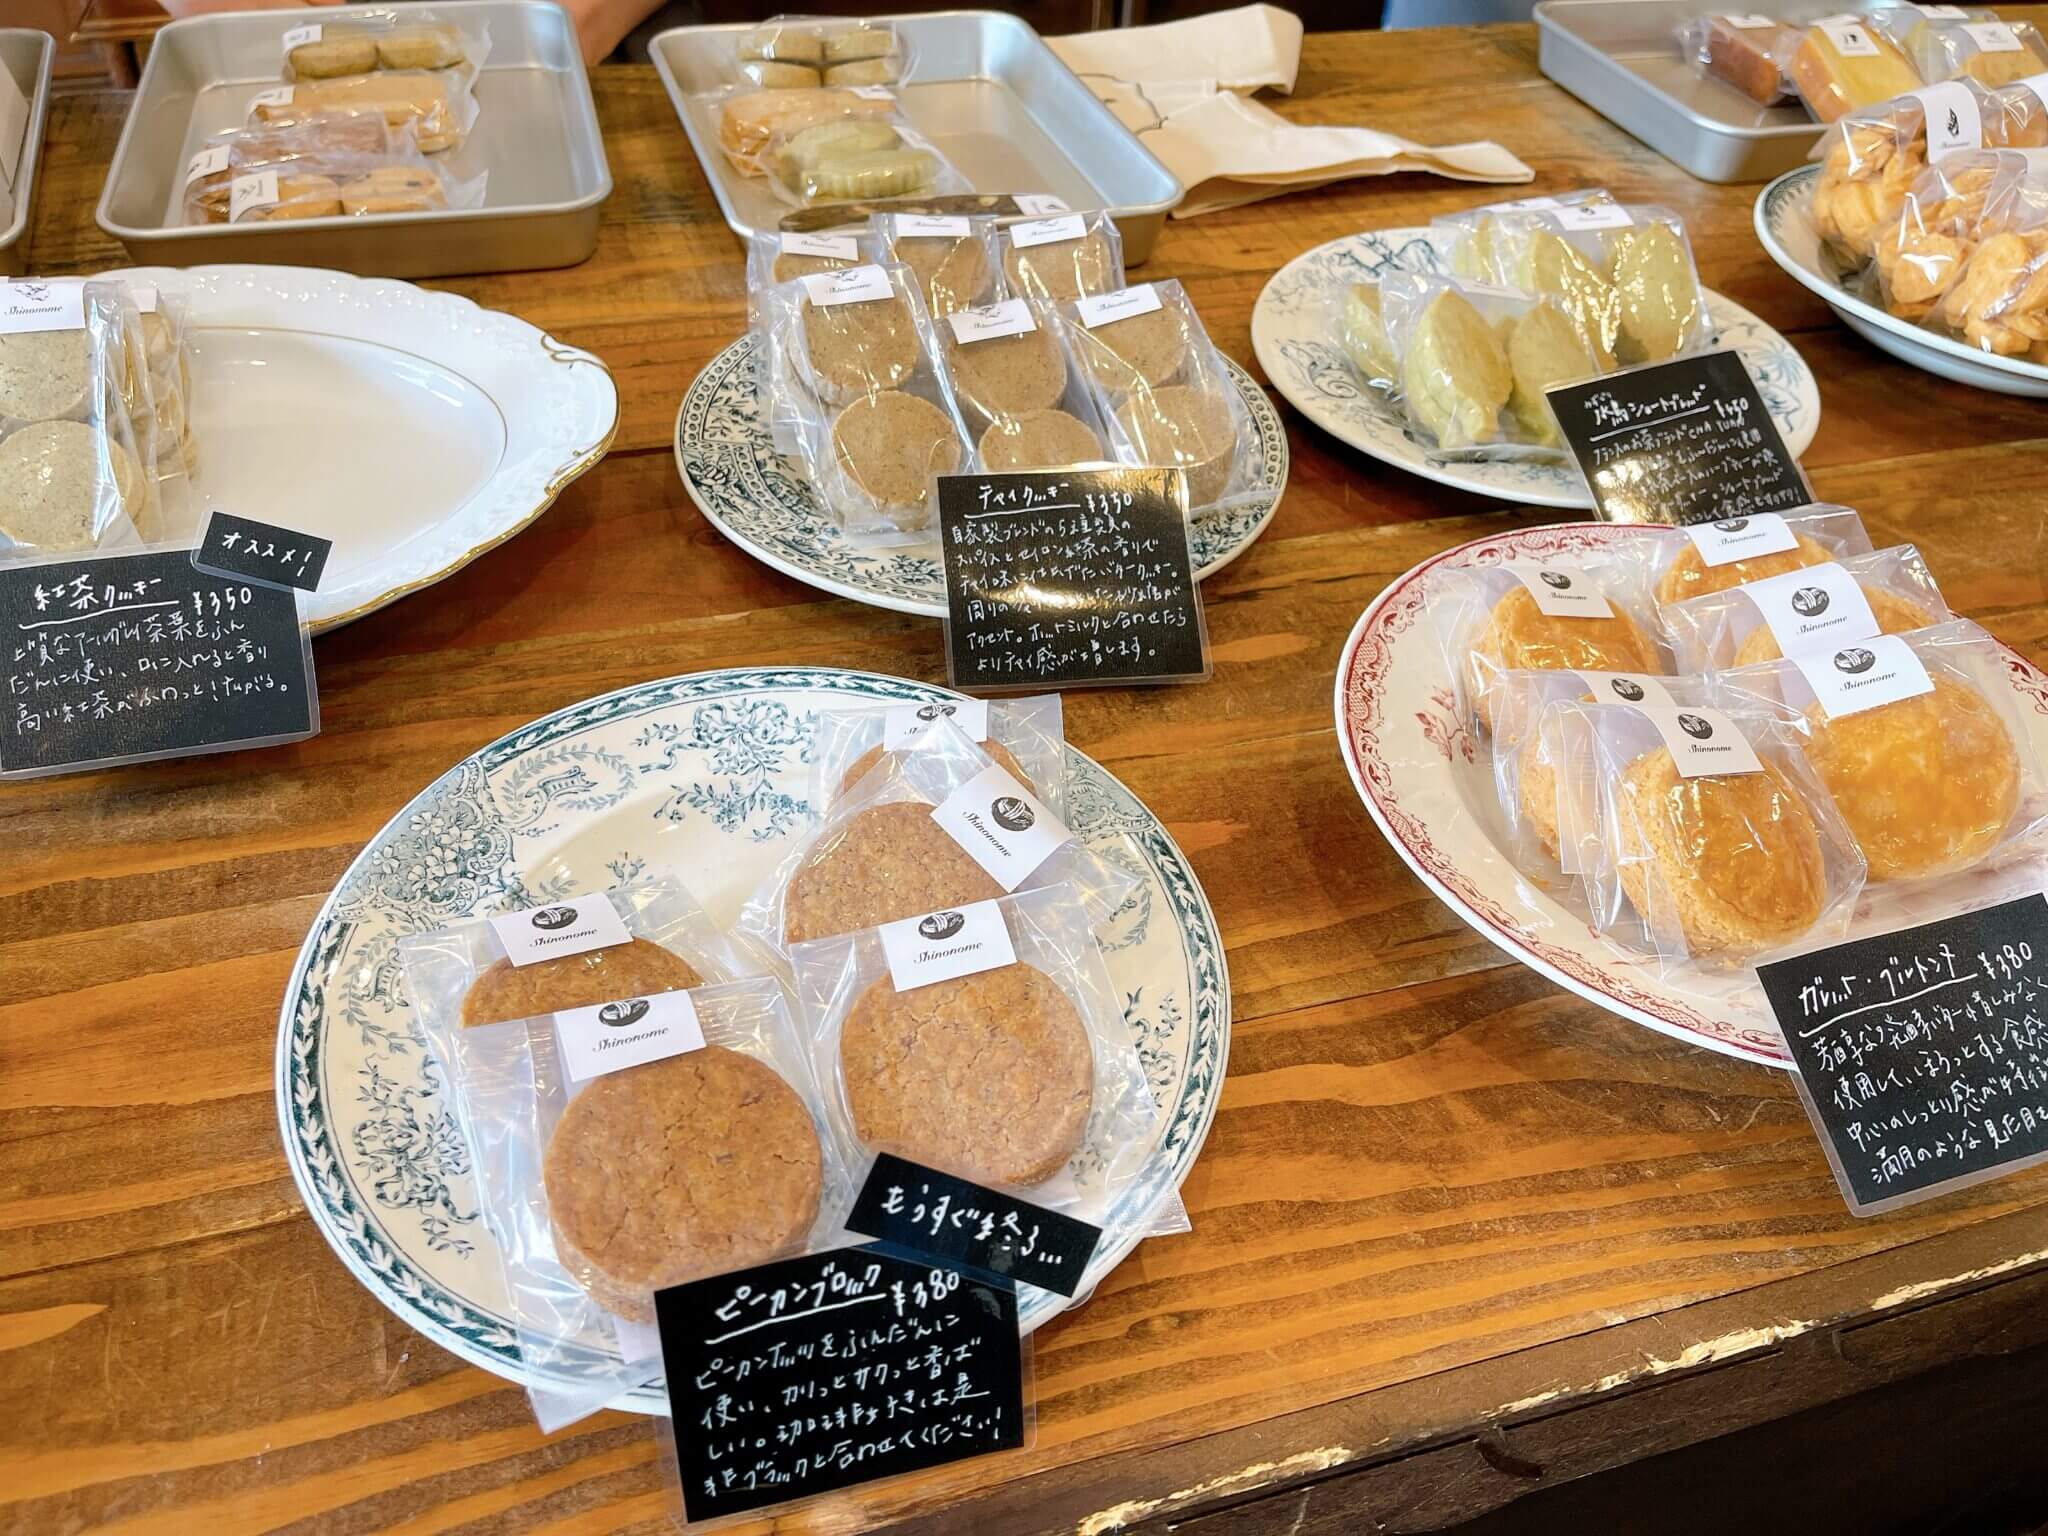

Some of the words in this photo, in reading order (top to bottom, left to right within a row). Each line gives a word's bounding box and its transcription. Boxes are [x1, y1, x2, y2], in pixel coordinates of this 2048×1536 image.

[979, 482, 1070, 511] チャイクッキー
[1086, 493, 1133, 514] ¥350
[1718, 531, 1768, 547] Shinonome
[34, 574, 162, 611] 紅茶クッキー
[193, 586, 252, 616] ¥350
[1796, 614, 1849, 636] Shinonome
[1839, 669, 1898, 693] Shinonome
[1687, 743, 1733, 754] Shinonome
[962, 810, 1013, 858] Shinonome
[529, 928, 599, 949] Shinonome
[912, 938, 985, 966] Shinonome
[1977, 940, 2032, 980] ¥380
[591, 1026, 670, 1054] Shinonome
[715, 1262, 881, 1320] ピーカンブロック
[892, 1269, 960, 1316] ¥380
